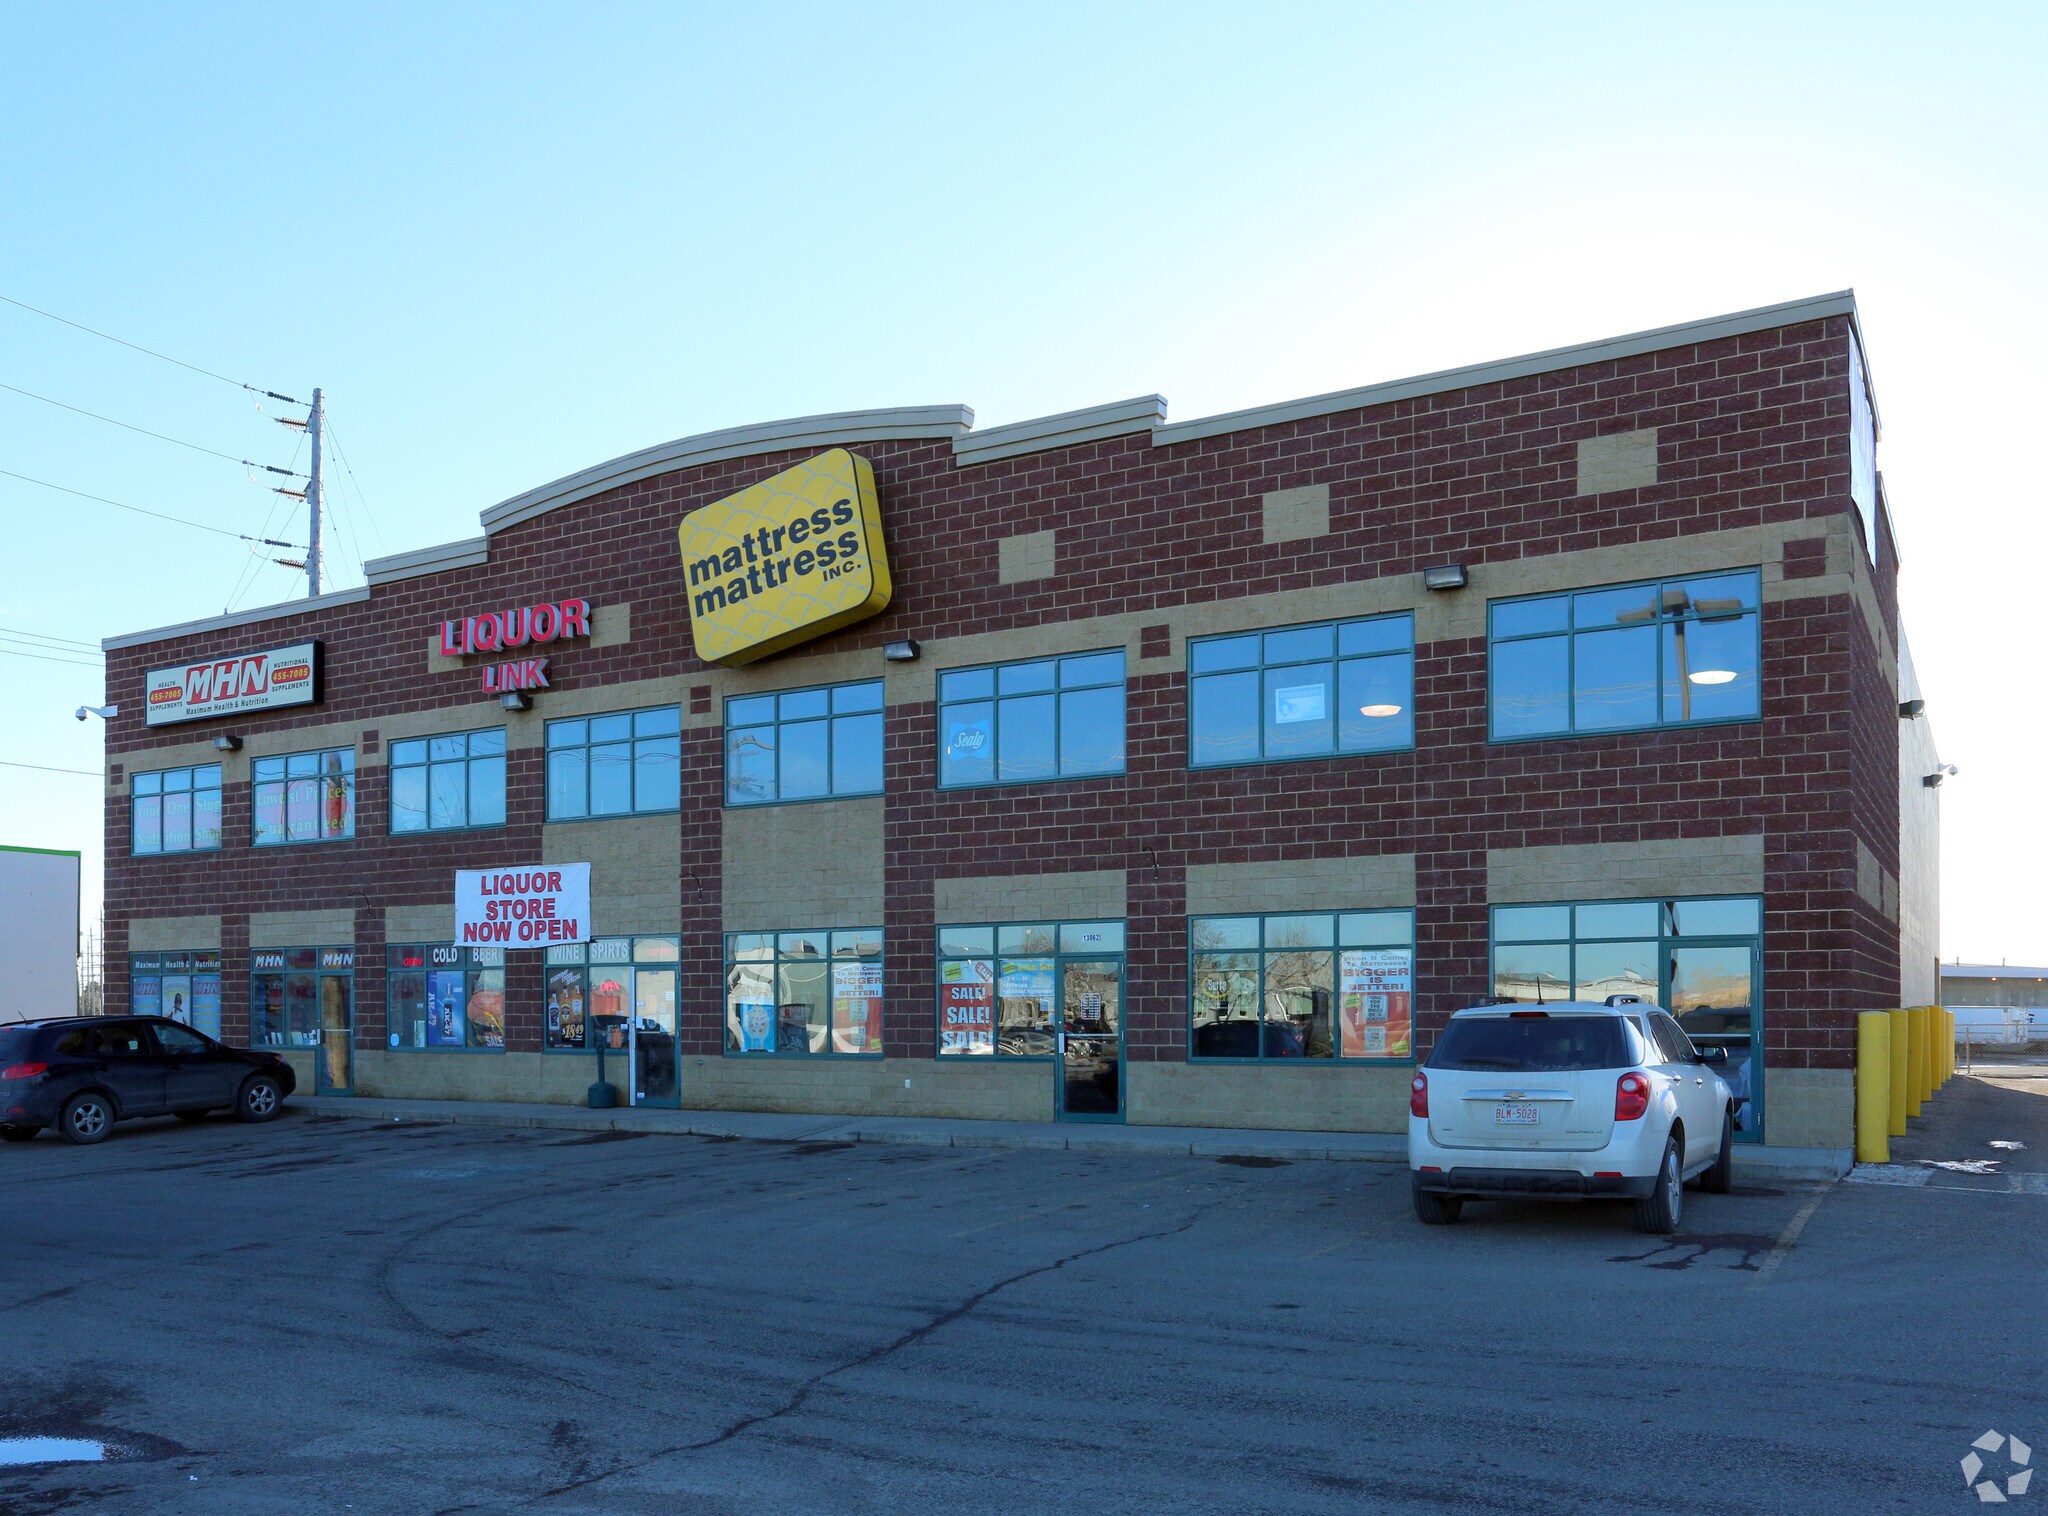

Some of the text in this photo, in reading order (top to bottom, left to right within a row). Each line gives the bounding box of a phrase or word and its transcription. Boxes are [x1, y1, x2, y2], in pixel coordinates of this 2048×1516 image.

[689, 499, 854, 587] mattress
[694, 530, 859, 618] mattress
[822, 560, 862, 583] INC.
[440, 598, 591, 657] LIQUOR
[273, 658, 309, 669] NUTRITIONAL
[185, 654, 269, 706] MHN
[272, 667, 309, 682] 455-7005
[482, 658, 550, 694] LINK
[157, 680, 177, 689] HEALTH
[271, 681, 310, 693] SUPPLEMENTS
[149, 689, 182, 702] 455-7005
[149, 701, 183, 712] SUPPLEMENTS
[185, 697, 269, 716] Maximum Health & Nutrition
[954, 731, 985, 749] Sealy
[255, 785, 348, 807] Lowest Prices
[136, 804, 161, 818] Your
[166, 800, 191, 816] One
[257, 811, 352, 836] Guaranteed!
[481, 871, 562, 896] LIQUOR
[486, 898, 556, 921] STORE
[463, 919, 578, 943] NOW OPEN
[433, 947, 498, 963] COLD BEER
[553, 945, 580, 961] WINE
[591, 942, 629, 959] SPIRTS
[165, 961, 185, 969] Health
[185, 960, 190, 968] &
[254, 955, 284, 968] MHN
[322, 953, 354, 966] MHN
[402, 957, 423, 967] OPEN
[977, 963, 992, 980] SALE
[1343, 967, 1409, 977] BIGGER
[599, 981, 620, 992] OPEN
[835, 977, 882, 985] BIGGER
[1348, 983, 1405, 991] BETTER!
[951, 986, 987, 1000] SALE!
[946, 1006, 990, 1024] SALE!
[485, 1035, 505, 1047] SALE
[1495, 1108, 1538, 1119] BLM-5028
